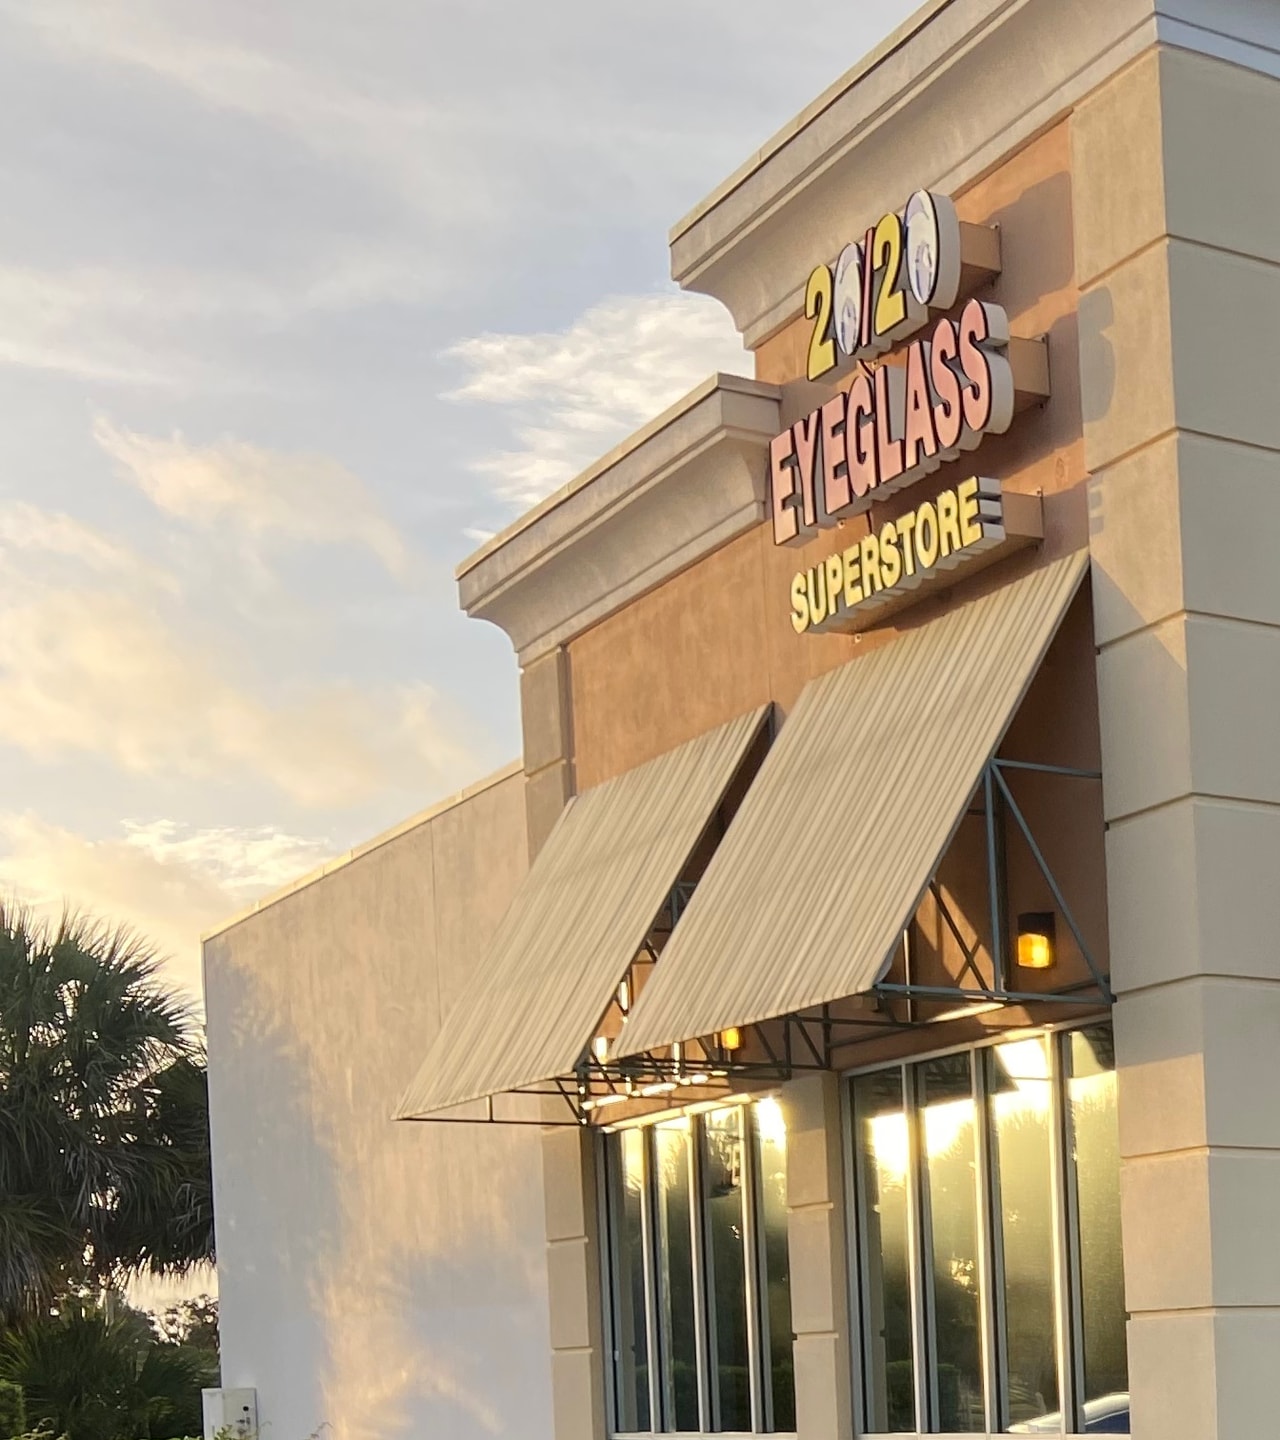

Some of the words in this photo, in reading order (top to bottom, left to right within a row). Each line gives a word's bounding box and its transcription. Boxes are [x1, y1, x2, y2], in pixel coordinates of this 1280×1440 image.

[805, 189, 938, 381] 20/20
[770, 299, 991, 545] EYEGLASS
[790, 475, 985, 633] SUPERSTORE
